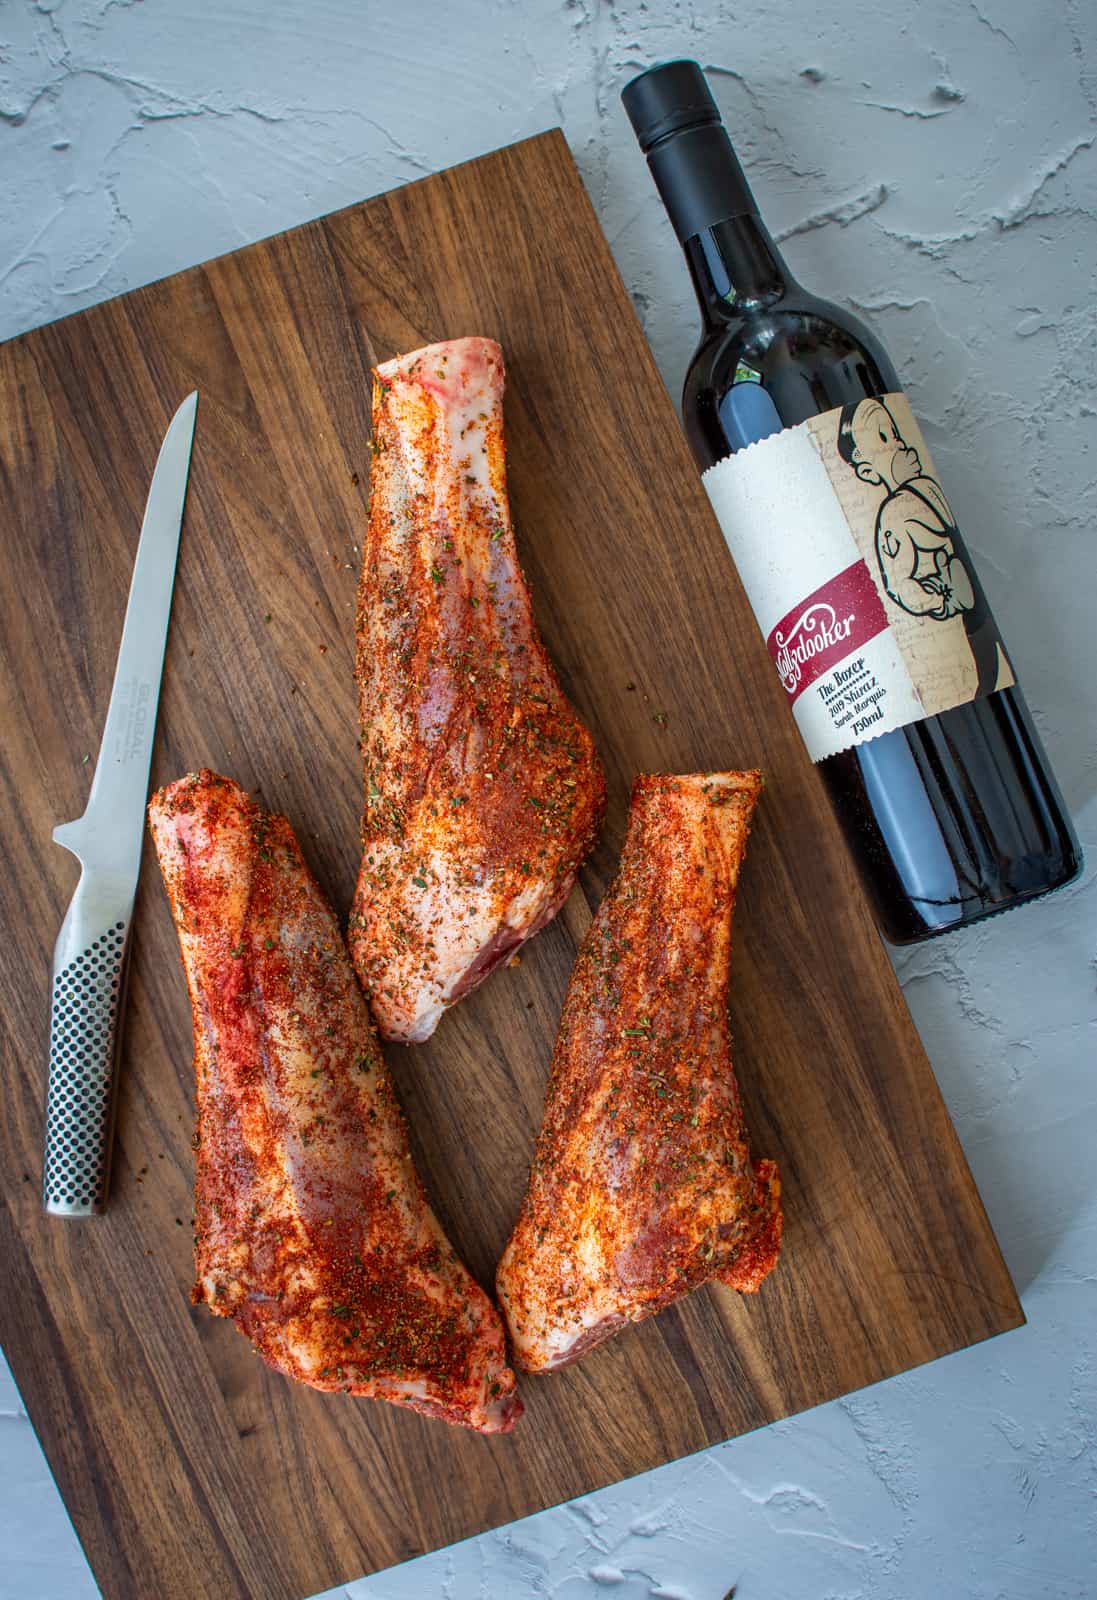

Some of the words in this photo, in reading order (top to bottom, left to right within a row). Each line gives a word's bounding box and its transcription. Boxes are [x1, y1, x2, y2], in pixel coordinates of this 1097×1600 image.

[816, 683, 836, 701] The
[833, 657, 865, 686] Boxer
[829, 700, 845, 718] 2019
[843, 677, 879, 705] Shiraz
[834, 711, 854, 729] Sarah
[853, 687, 887, 714] Marquis
[850, 706, 884, 736] 750ml
